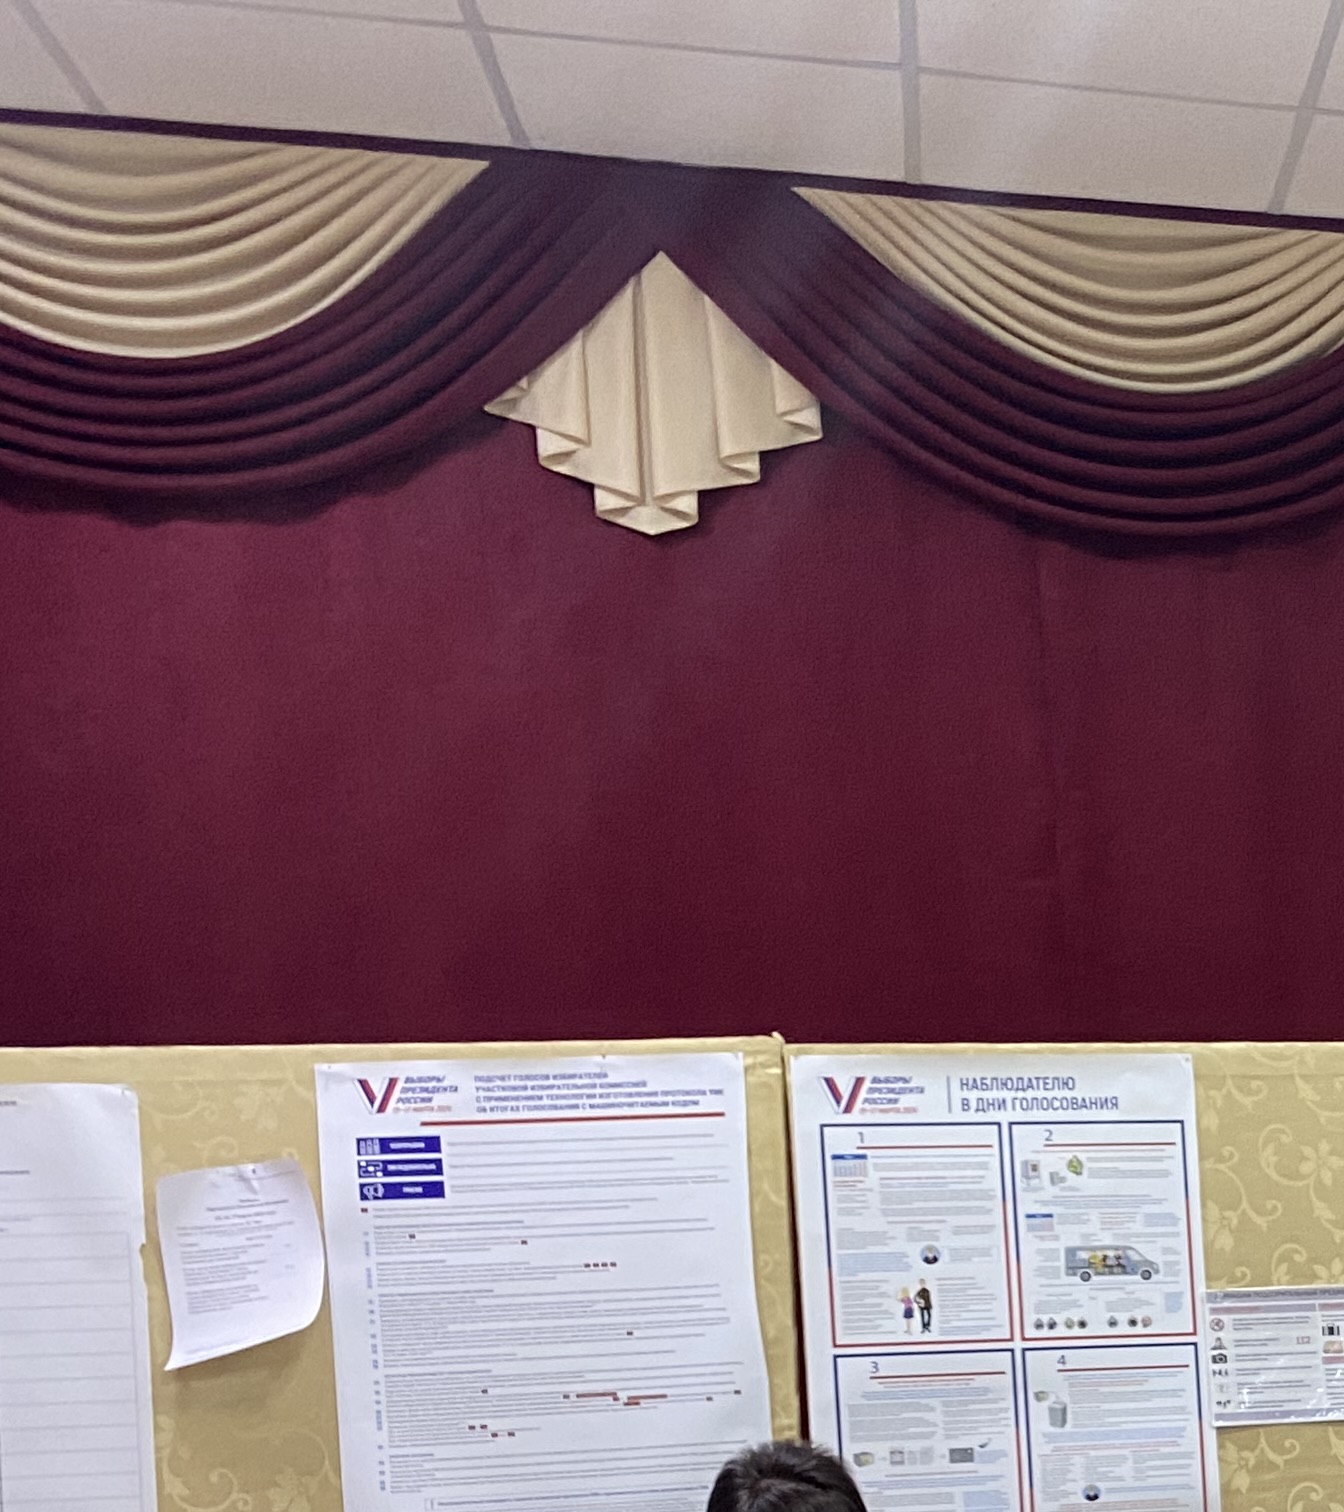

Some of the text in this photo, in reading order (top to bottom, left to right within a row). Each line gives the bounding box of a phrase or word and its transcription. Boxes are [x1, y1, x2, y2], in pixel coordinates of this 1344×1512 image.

[959, 1076, 1076, 1092] НАБЛЮДАТЕЛЮ
[961, 1096, 1119, 1113] В ДНИ ГОЛОСОВАНИЯ
[858, 1131, 864, 1144] 1
[1044, 1129, 1054, 1142] 2
[1057, 1355, 1066, 1365] 4
[869, 1361, 879, 1373] 3
